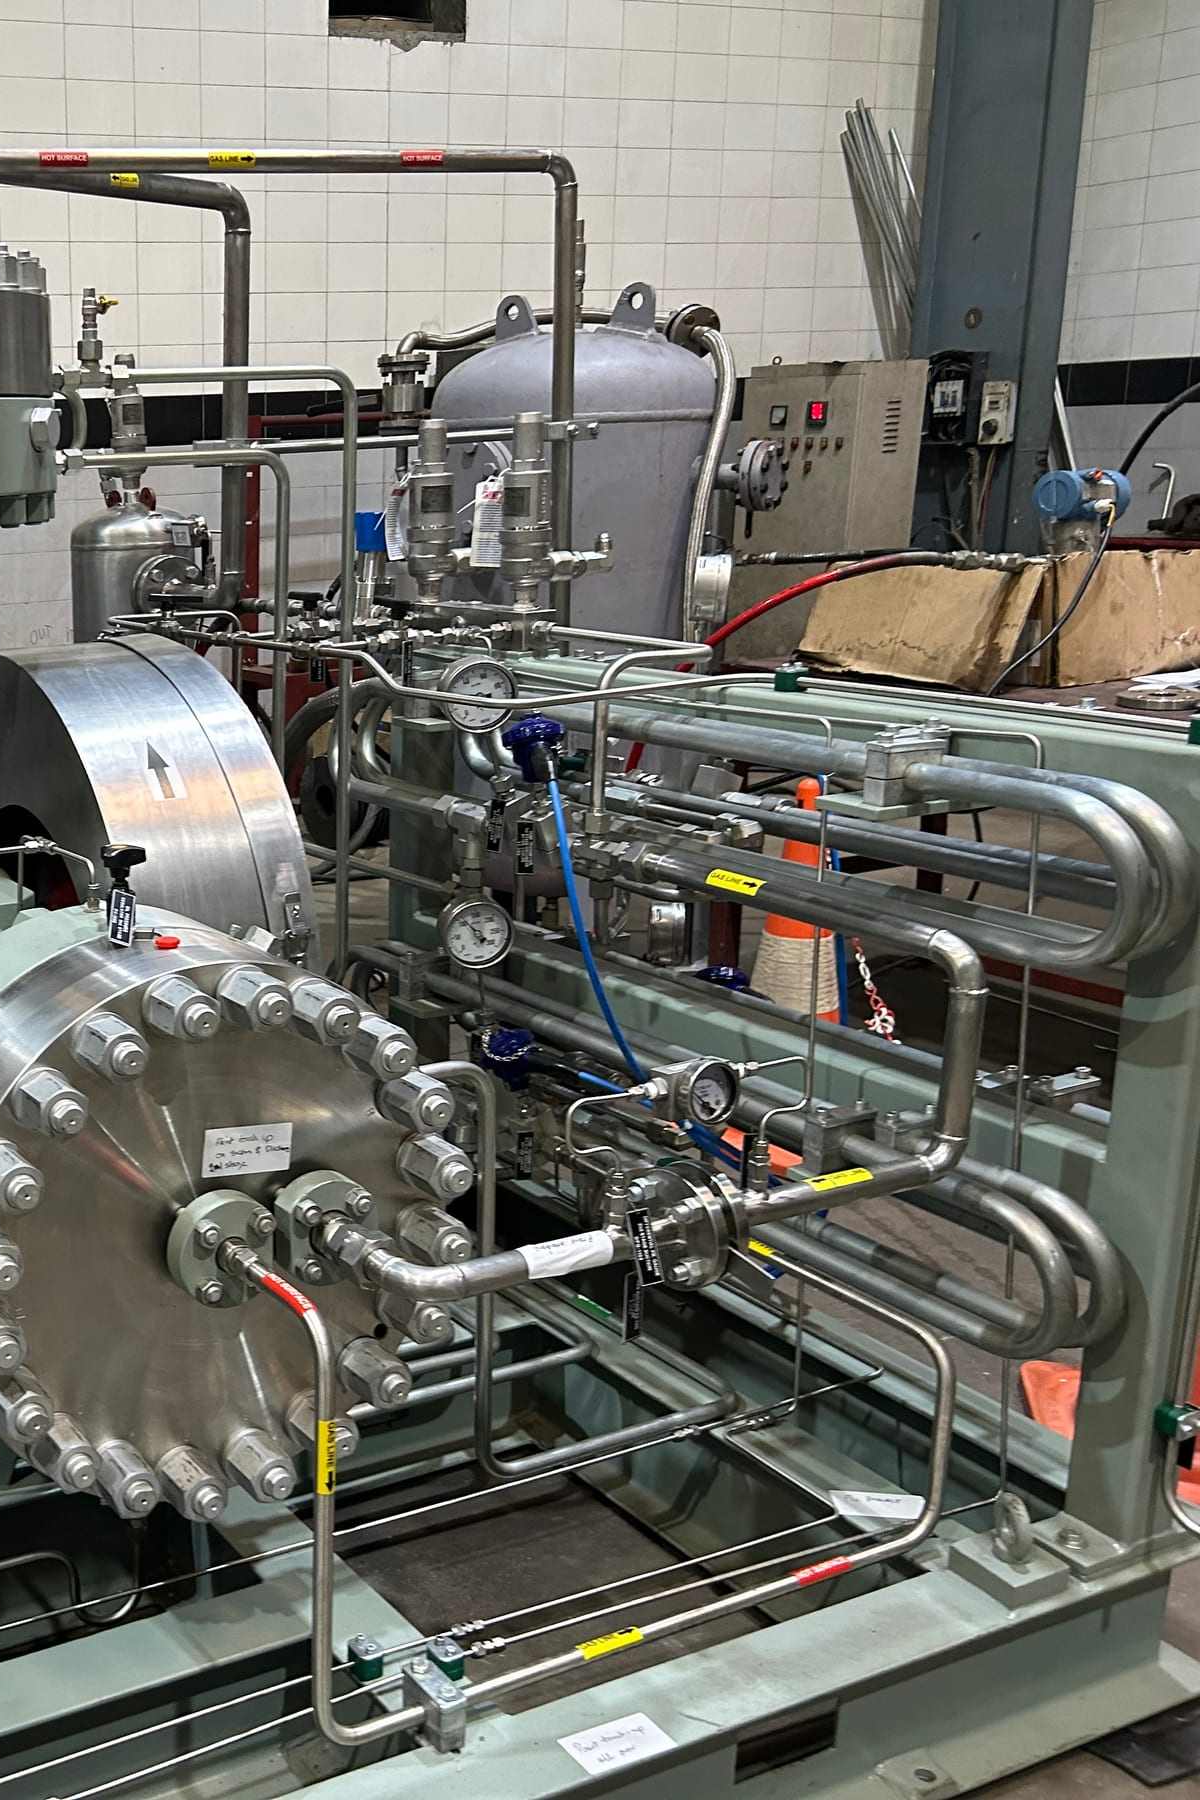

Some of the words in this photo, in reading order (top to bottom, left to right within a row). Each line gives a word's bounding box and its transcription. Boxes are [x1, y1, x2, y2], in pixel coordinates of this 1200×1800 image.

[41, 153, 55, 162] HOT
[56, 153, 88, 162] SURFACE
[209, 154, 223, 163] GAS
[224, 154, 239, 163] LINE
[402, 154, 414, 162] HOT
[415, 154, 443, 162] SURFACE
[31, 624, 53, 645] OUT
[710, 872, 725, 881] GAS
[327, 1422, 336, 1443] GAS
[327, 1445, 336, 1467] LINE
